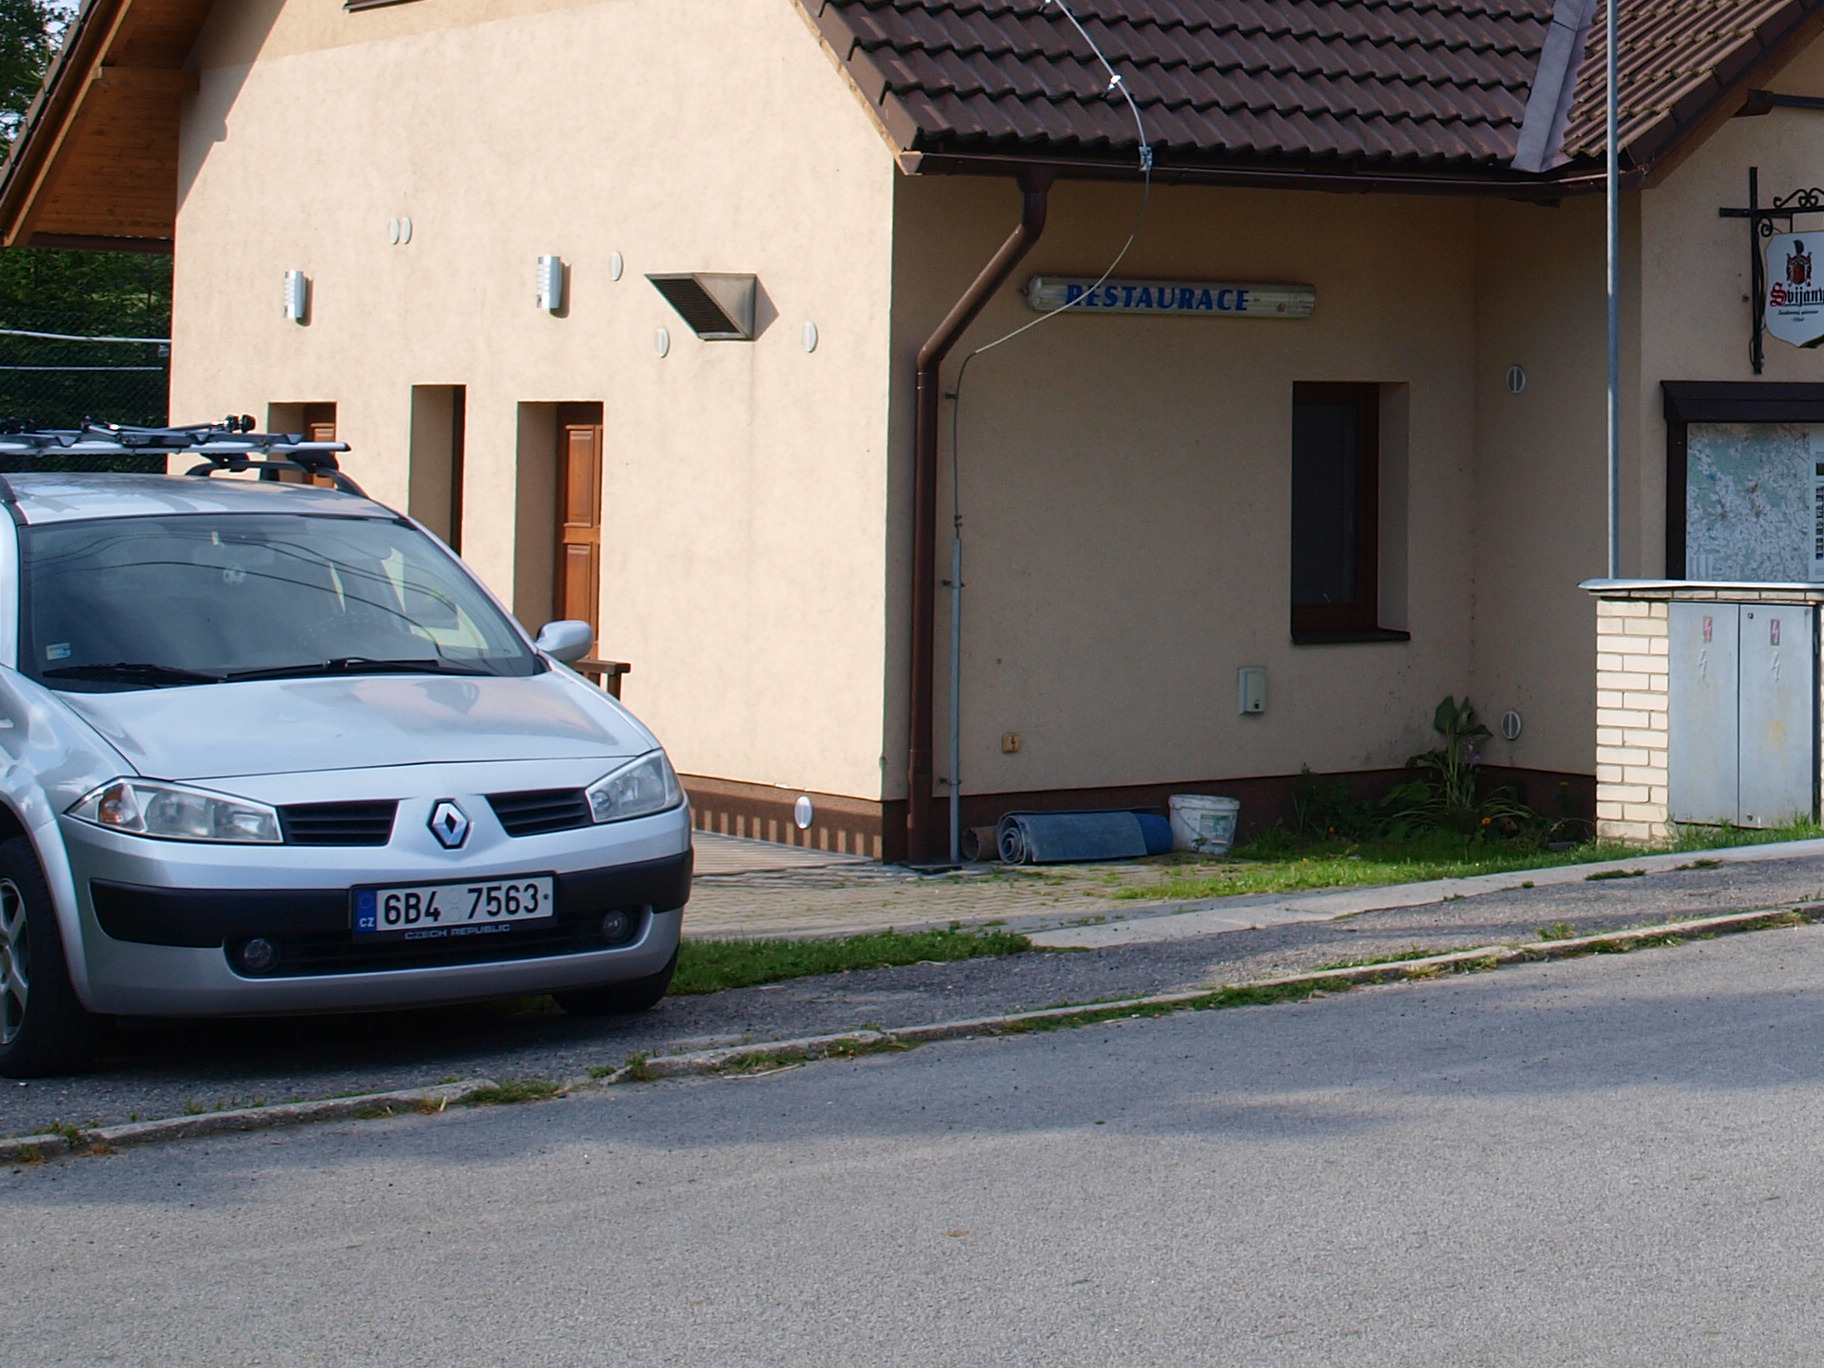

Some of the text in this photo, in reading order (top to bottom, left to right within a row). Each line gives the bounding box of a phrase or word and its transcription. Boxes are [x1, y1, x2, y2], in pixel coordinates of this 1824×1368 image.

[1065, 284, 1249, 311] RESTAURACE
[384, 883, 539, 925] 6B4 7563
[359, 917, 375, 928] CZ
[404, 924, 511, 940] CZECH REPUBLIC
